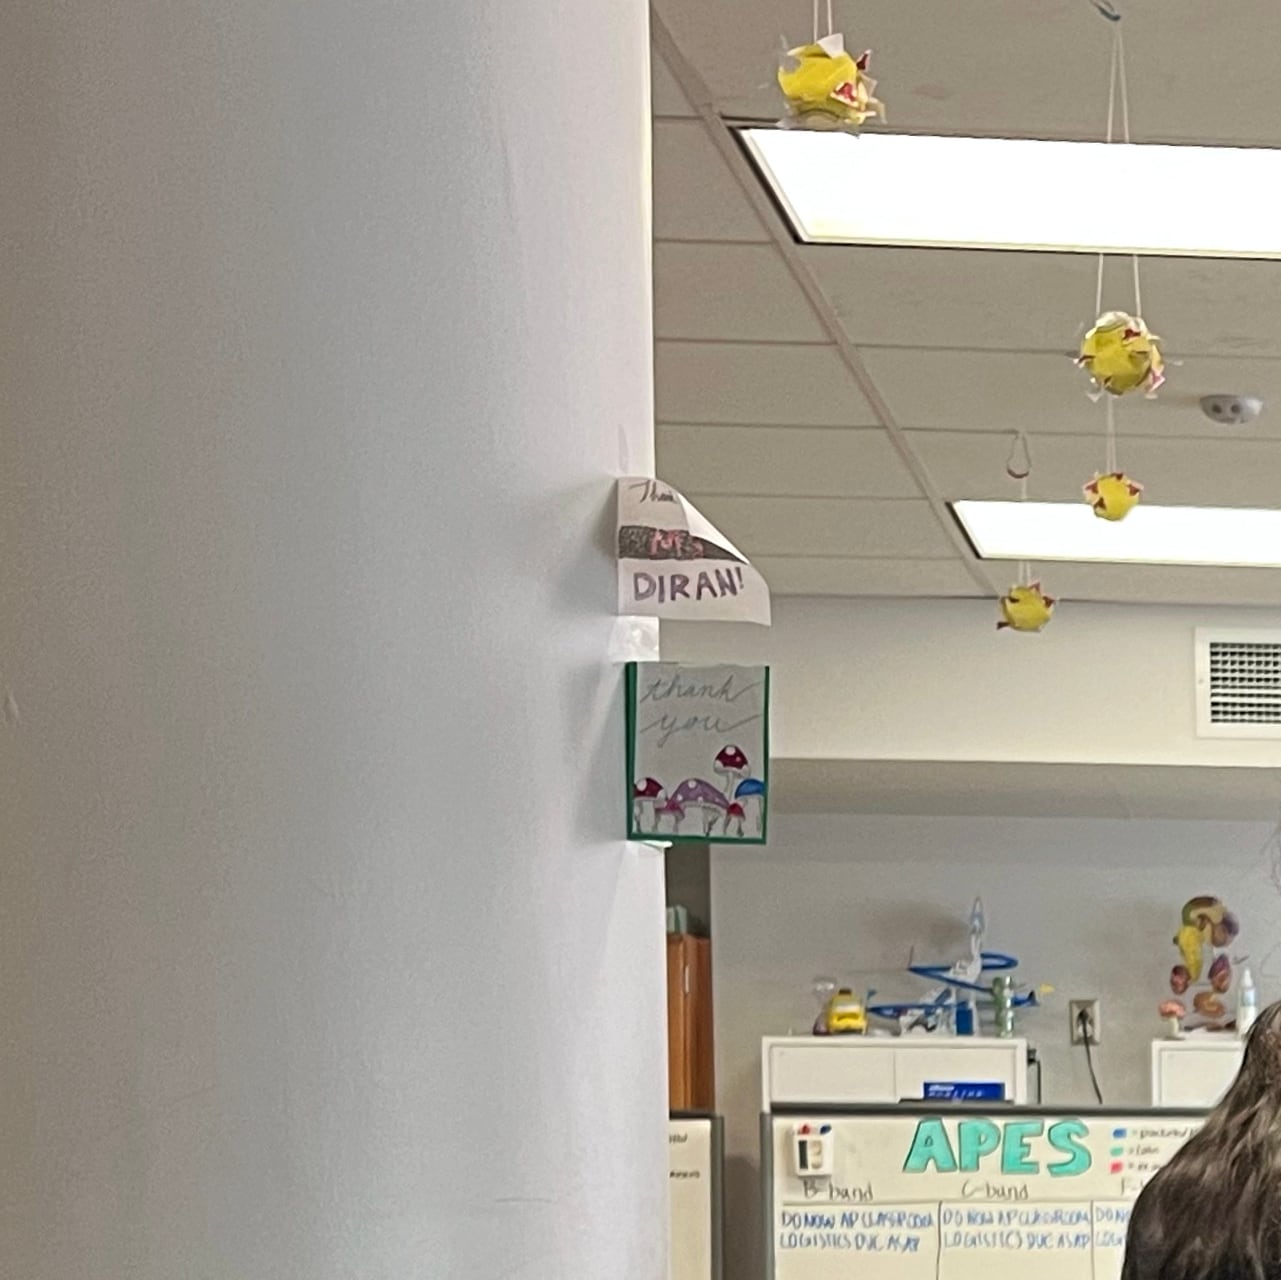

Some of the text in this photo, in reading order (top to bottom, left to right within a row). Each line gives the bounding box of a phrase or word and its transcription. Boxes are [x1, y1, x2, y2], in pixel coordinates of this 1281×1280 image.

[633, 566, 744, 604] DIRAN!
[639, 674, 763, 703] thank
[639, 714, 763, 748] you
[903, 1116, 1092, 1178] APES
[961, 1179, 1029, 1200] C-band
